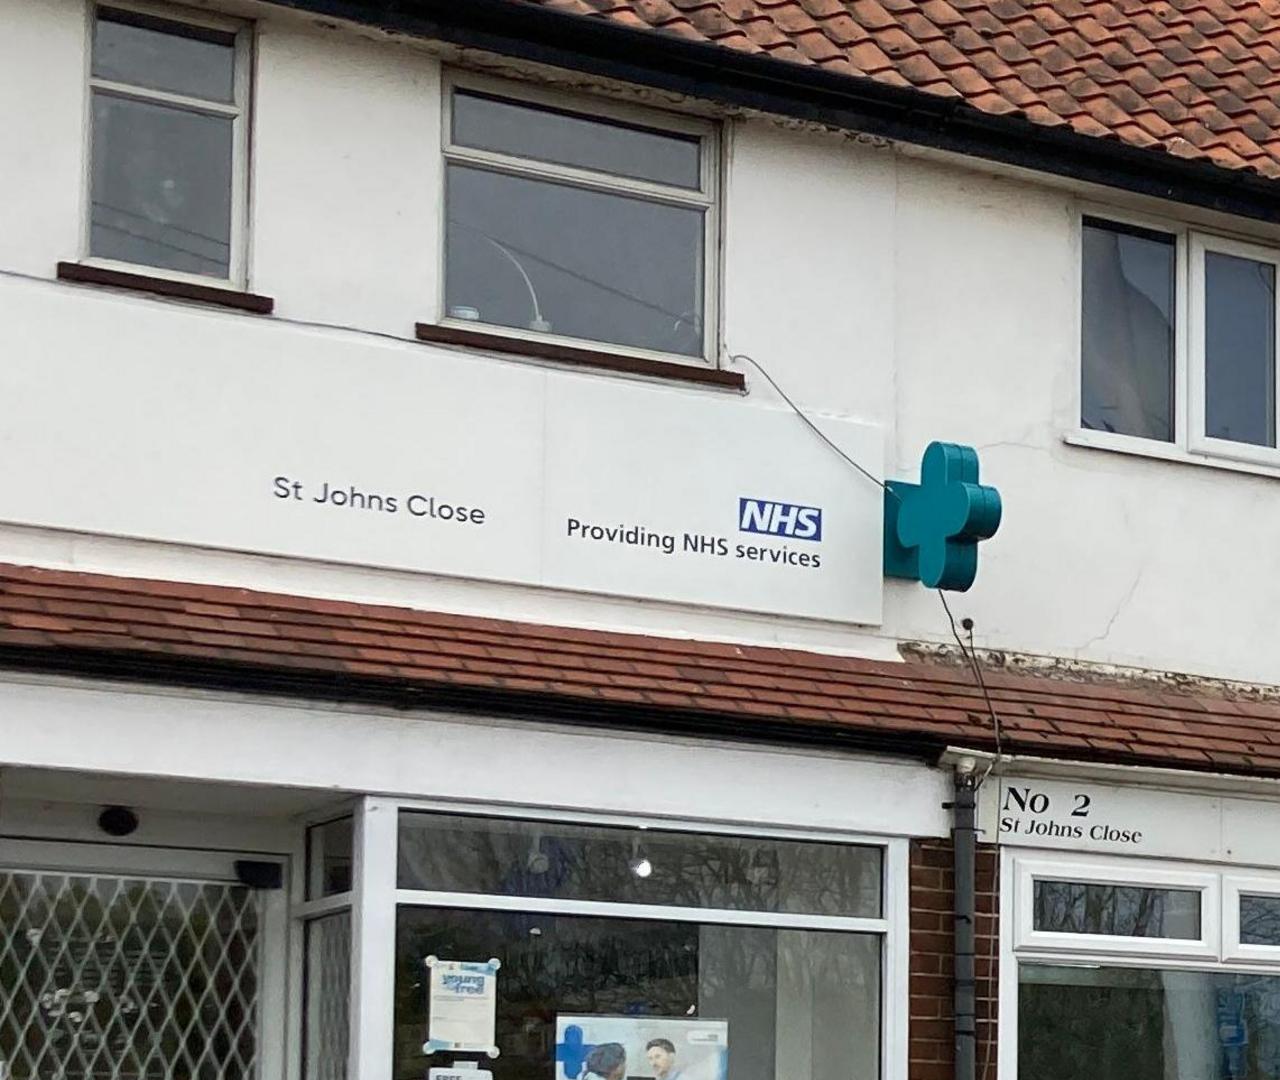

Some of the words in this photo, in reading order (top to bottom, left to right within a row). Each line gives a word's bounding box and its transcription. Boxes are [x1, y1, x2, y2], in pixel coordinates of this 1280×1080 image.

[273, 476, 304, 501] St
[313, 482, 398, 513] Johns
[406, 494, 486, 525] Close
[740, 500, 818, 538] NHS
[567, 518, 676, 554] Providing
[683, 533, 729, 556] NHS
[735, 544, 821, 568] services
[1002, 786, 1050, 814] No
[1071, 794, 1091, 817] 2
[1000, 817, 1021, 833] St
[1025, 819, 1084, 839] Johns
[1089, 824, 1143, 844] Close
